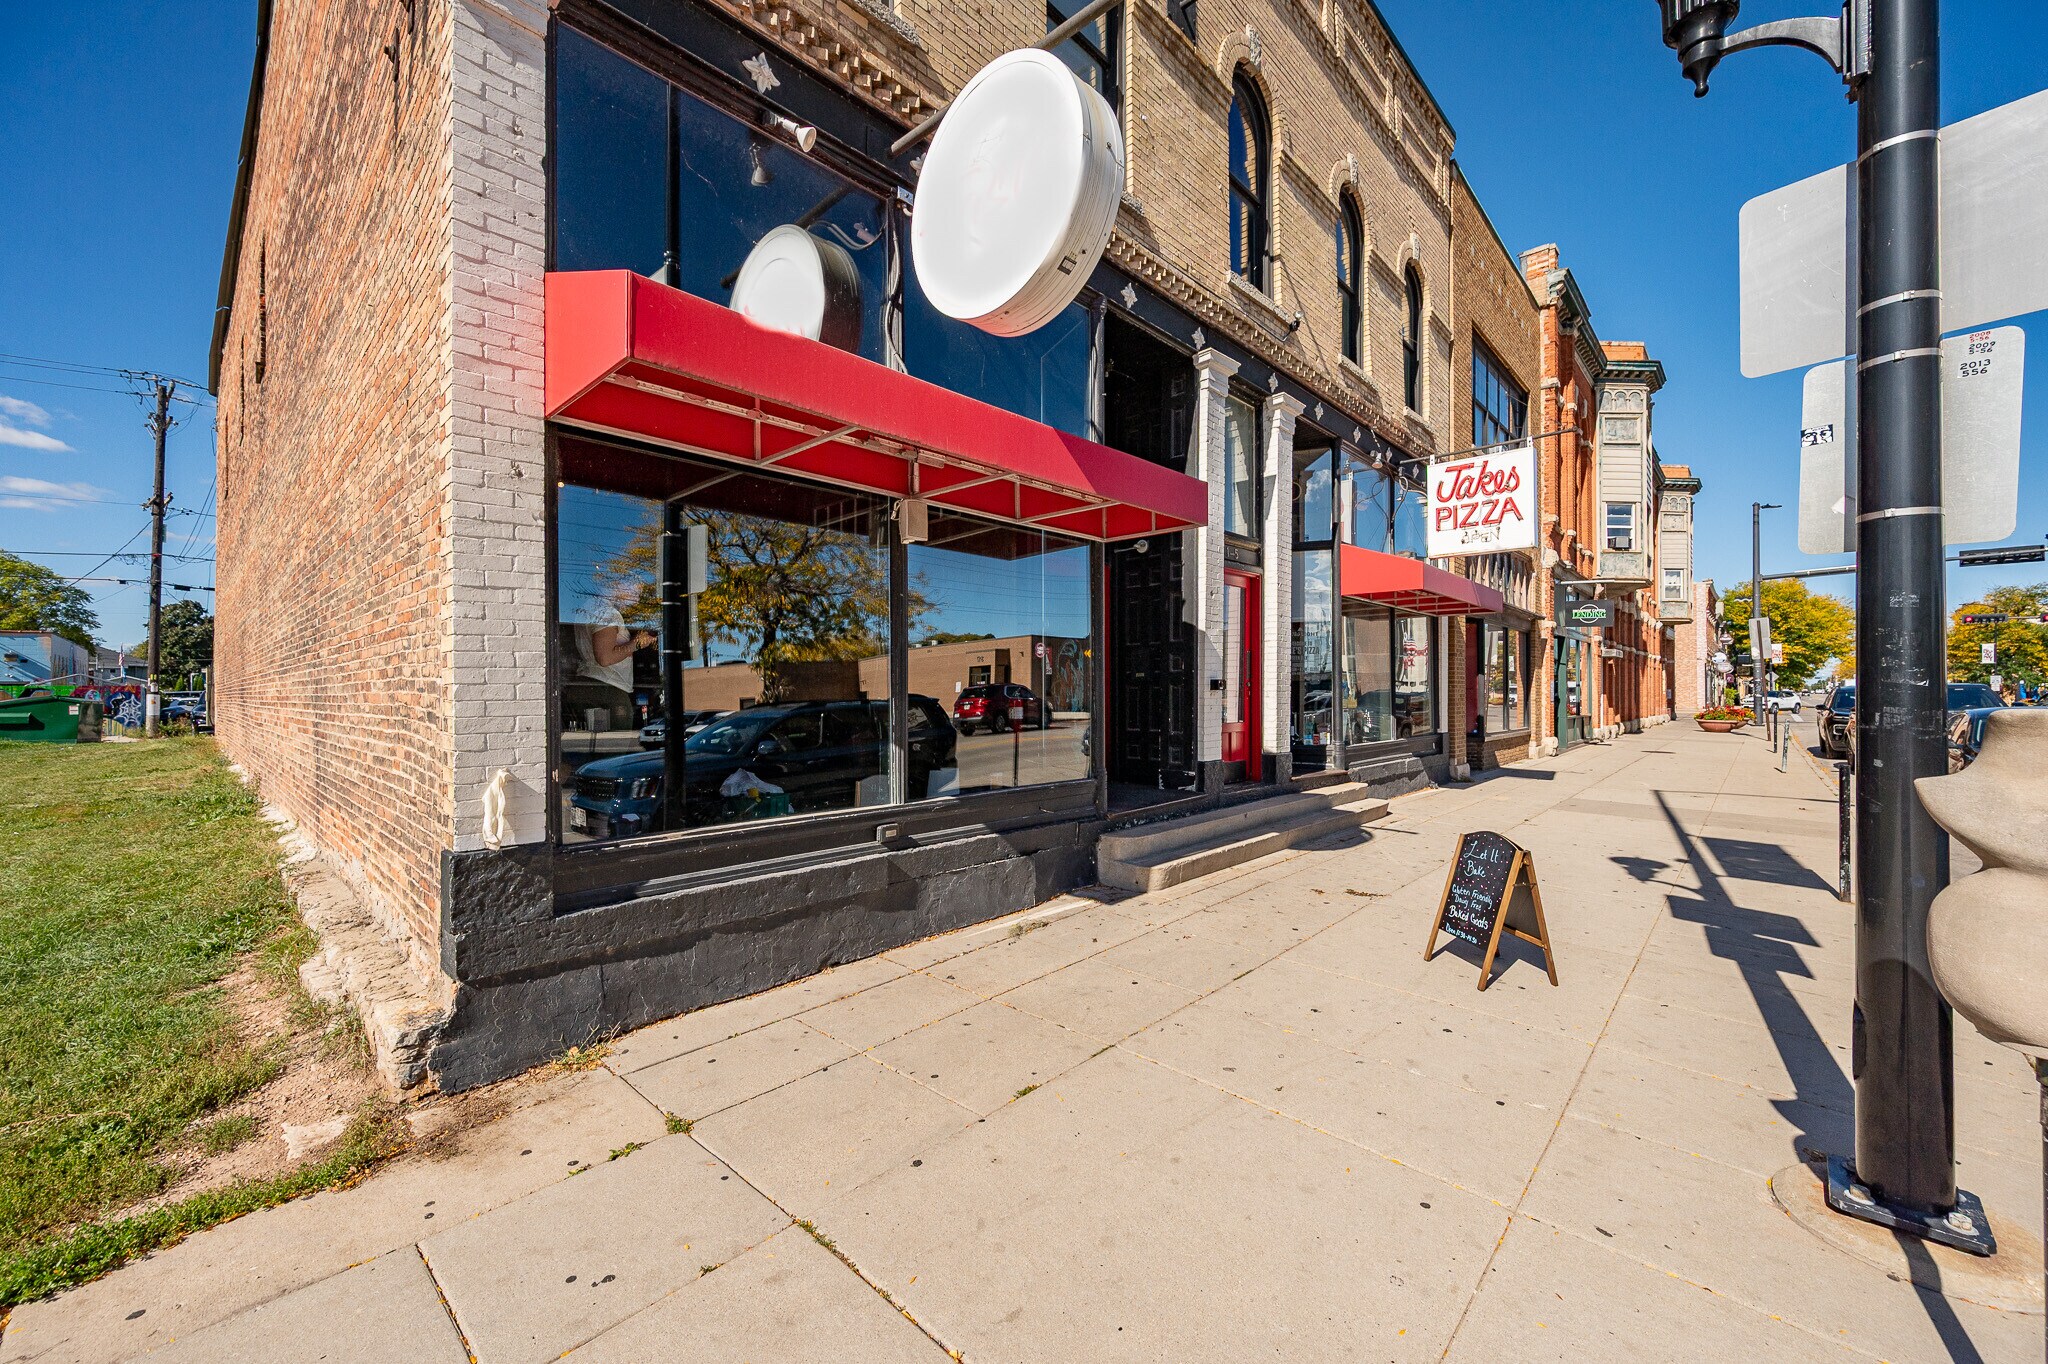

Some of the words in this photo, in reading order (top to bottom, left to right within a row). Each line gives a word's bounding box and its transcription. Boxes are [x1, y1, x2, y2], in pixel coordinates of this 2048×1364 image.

[1968, 341, 1996, 350] 2009
[1959, 358, 1991, 370] 2013
[1961, 366, 1988, 378] 556
[1436, 460, 1521, 503] Jakes
[1435, 496, 1524, 532] PIZZA
[1571, 611, 1607, 620] LENDING
[1463, 840, 1487, 860] Let
[1489, 848, 1499, 863] It
[1463, 860, 1486, 877] Bake
[1448, 905, 1469, 921] Baked
[1470, 913, 1489, 930] Goods
